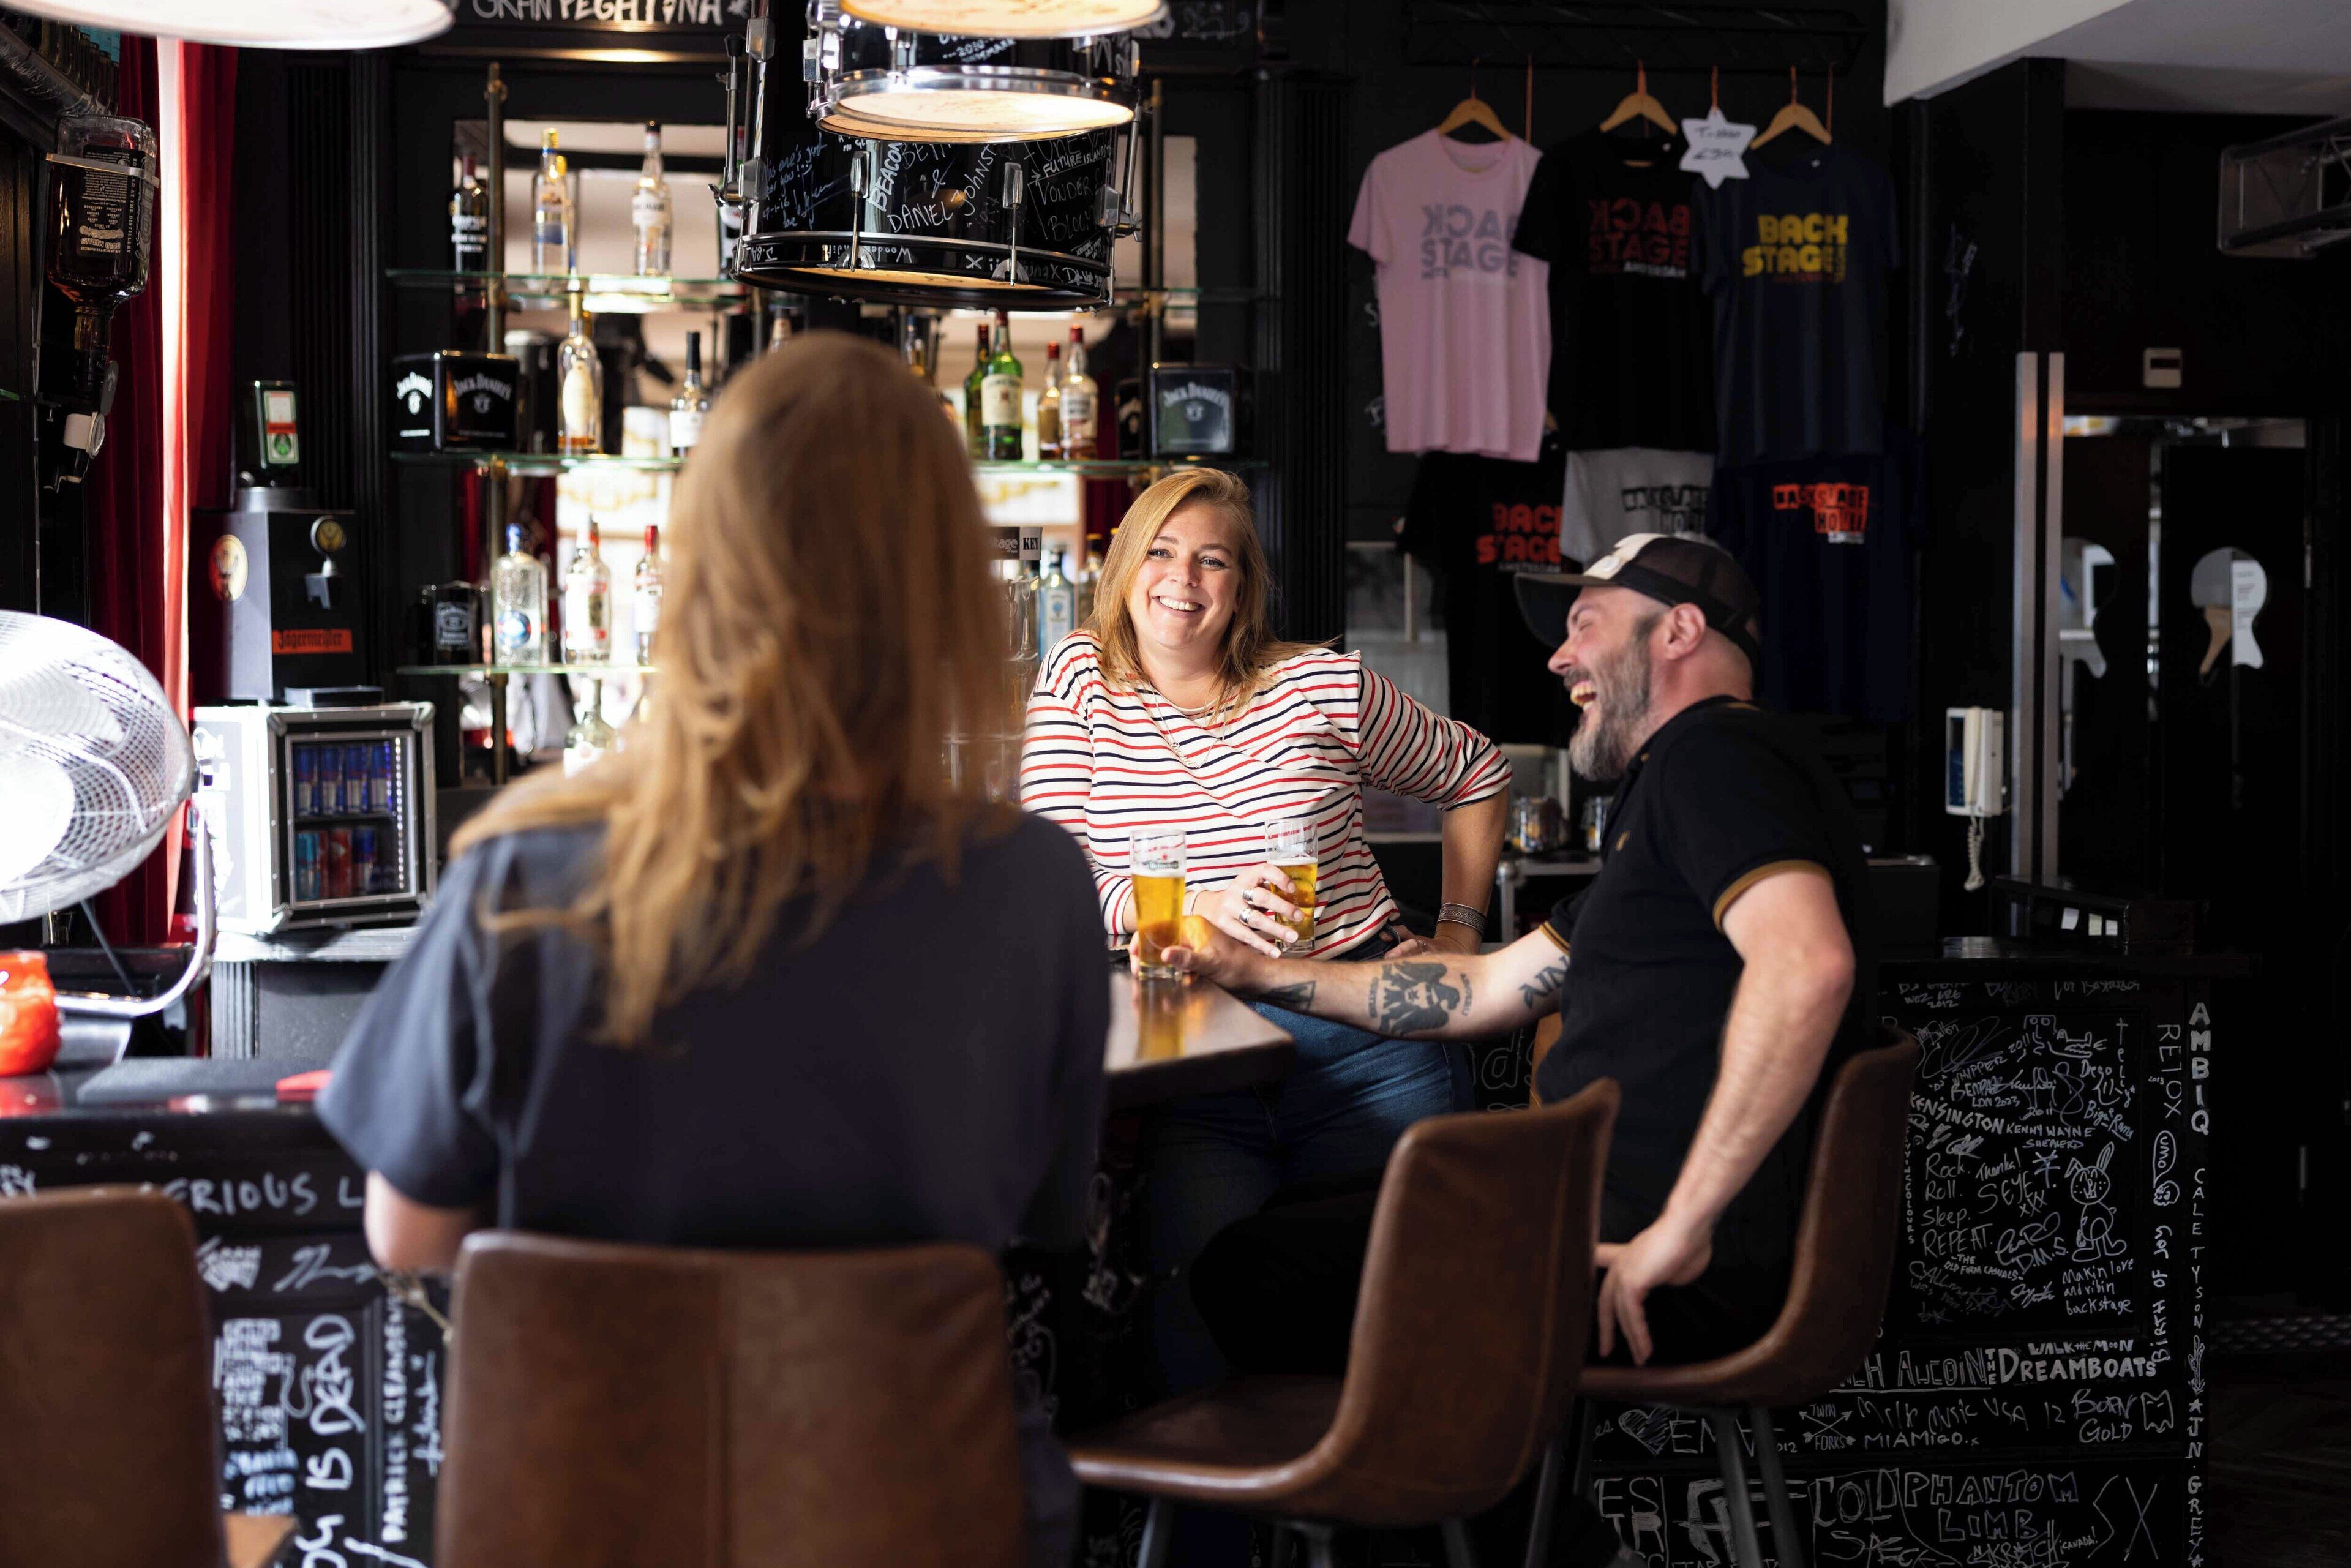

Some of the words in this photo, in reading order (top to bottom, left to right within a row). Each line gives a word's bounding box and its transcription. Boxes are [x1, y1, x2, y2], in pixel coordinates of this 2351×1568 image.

[1043, 151, 1082, 178] FUTURE
[887, 201, 954, 233] DANIEL
[1022, 537, 1039, 550] KEY
[2189, 1002, 2212, 1136] AMBIQ
[1910, 1091, 2005, 1135] KENSINGTON
[2006, 1122, 2042, 1137] KENNY
[2045, 1125, 2096, 1138] WAYNE
[1998, 1348, 2157, 1384] DREAMBOATS
[1809, 1403, 1837, 1419] TWIN
[1814, 1434, 1841, 1452] FORKS
[1903, 1469, 2079, 1508] PHANTOM
[1938, 1507, 2038, 1540] LIMB
